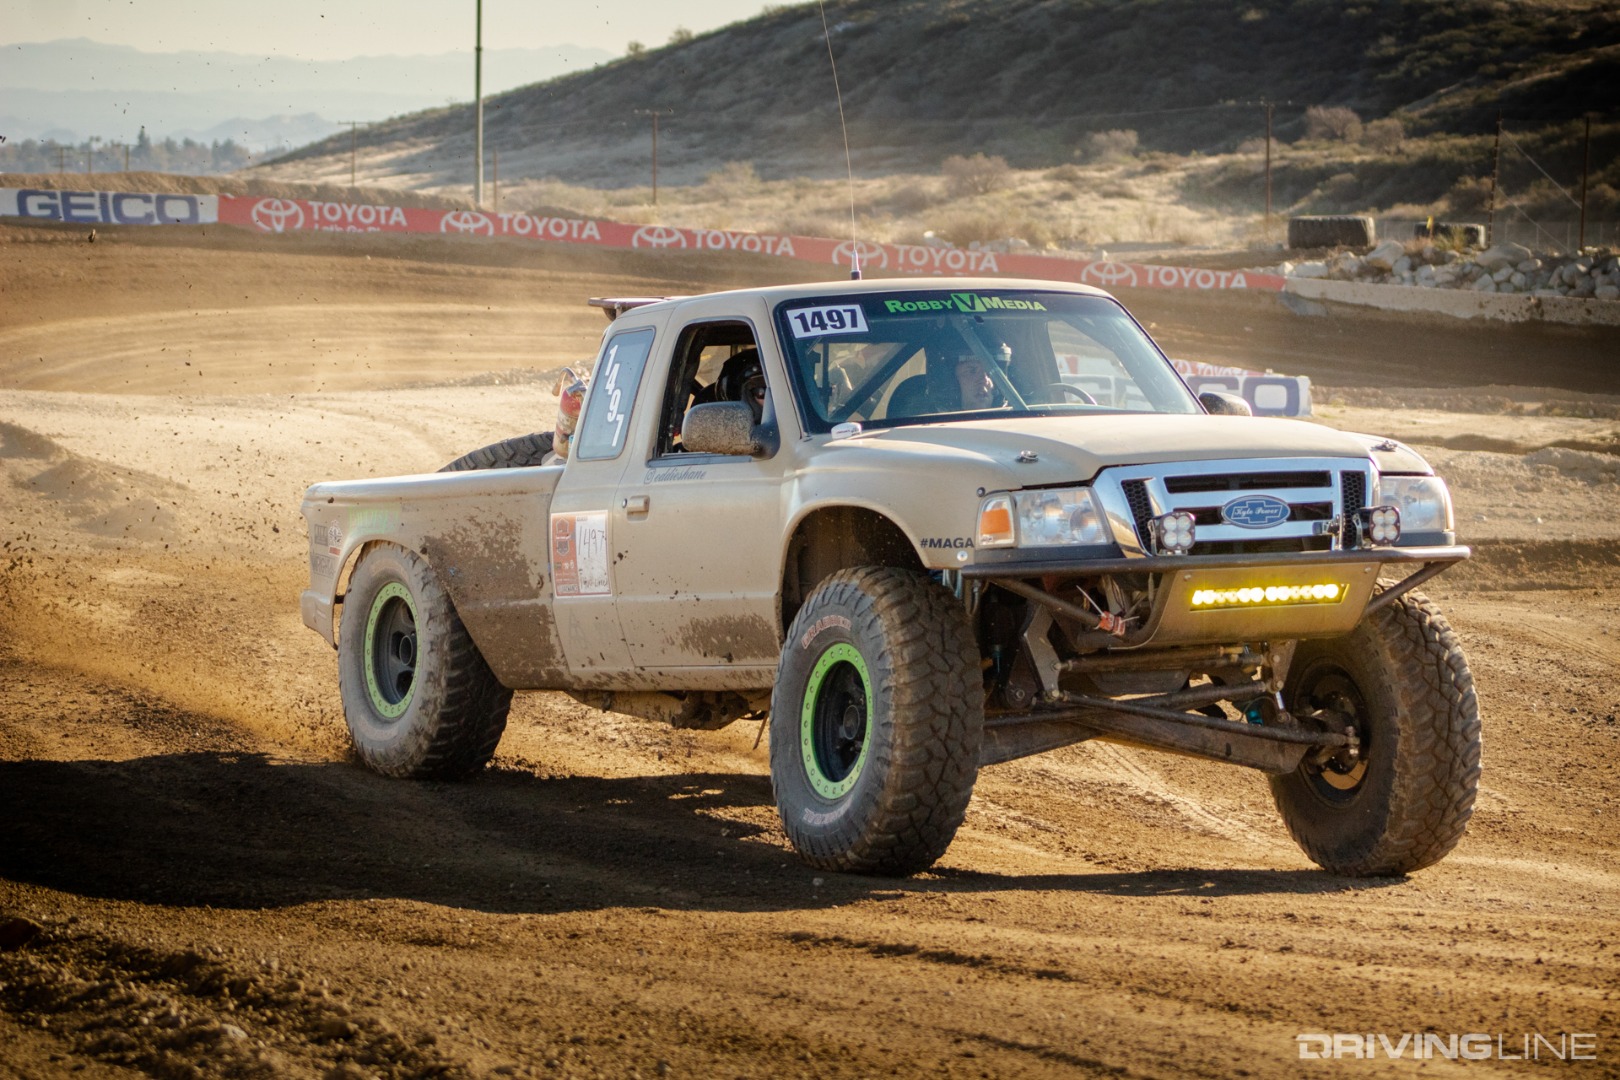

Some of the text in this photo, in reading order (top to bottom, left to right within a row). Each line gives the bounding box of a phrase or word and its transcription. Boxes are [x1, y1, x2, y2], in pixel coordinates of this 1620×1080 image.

[16, 189, 199, 225] GEICO
[308, 200, 408, 227] TOYOTA
[498, 213, 601, 240] TOYOTA
[691, 229, 795, 256] TOYOTA
[895, 245, 999, 272] TOYOTA
[1147, 265, 1247, 289] TOYOTA
[794, 309, 860, 333] 1497
[604, 345, 625, 447] 1497
[920, 537, 975, 549] #MAGA
